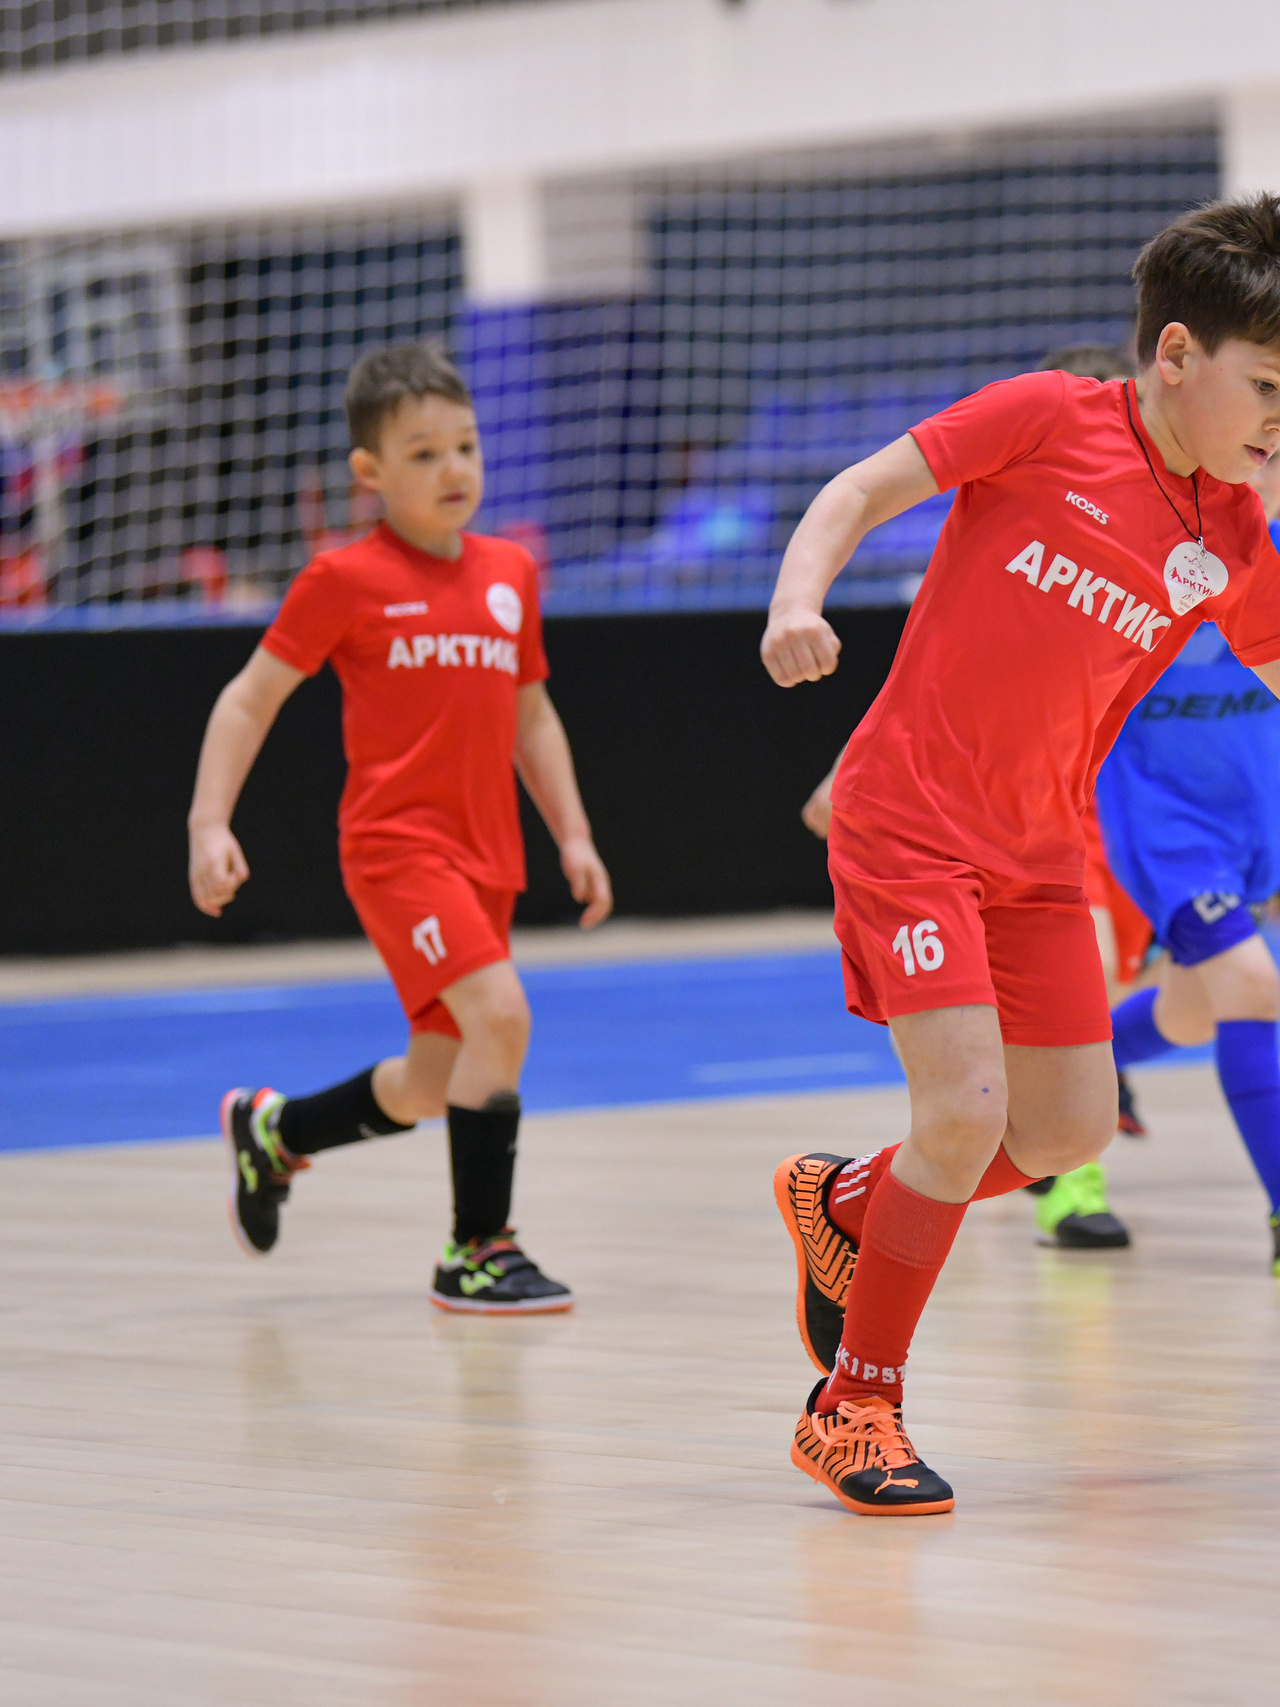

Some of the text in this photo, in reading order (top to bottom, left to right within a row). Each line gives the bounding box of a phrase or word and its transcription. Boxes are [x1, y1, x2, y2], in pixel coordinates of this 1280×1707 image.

[1065, 490, 1110, 525] KODES
[1005, 540, 1172, 652] АРКТИК
[412, 914, 448, 967] 17
[892, 919, 945, 977] 16
